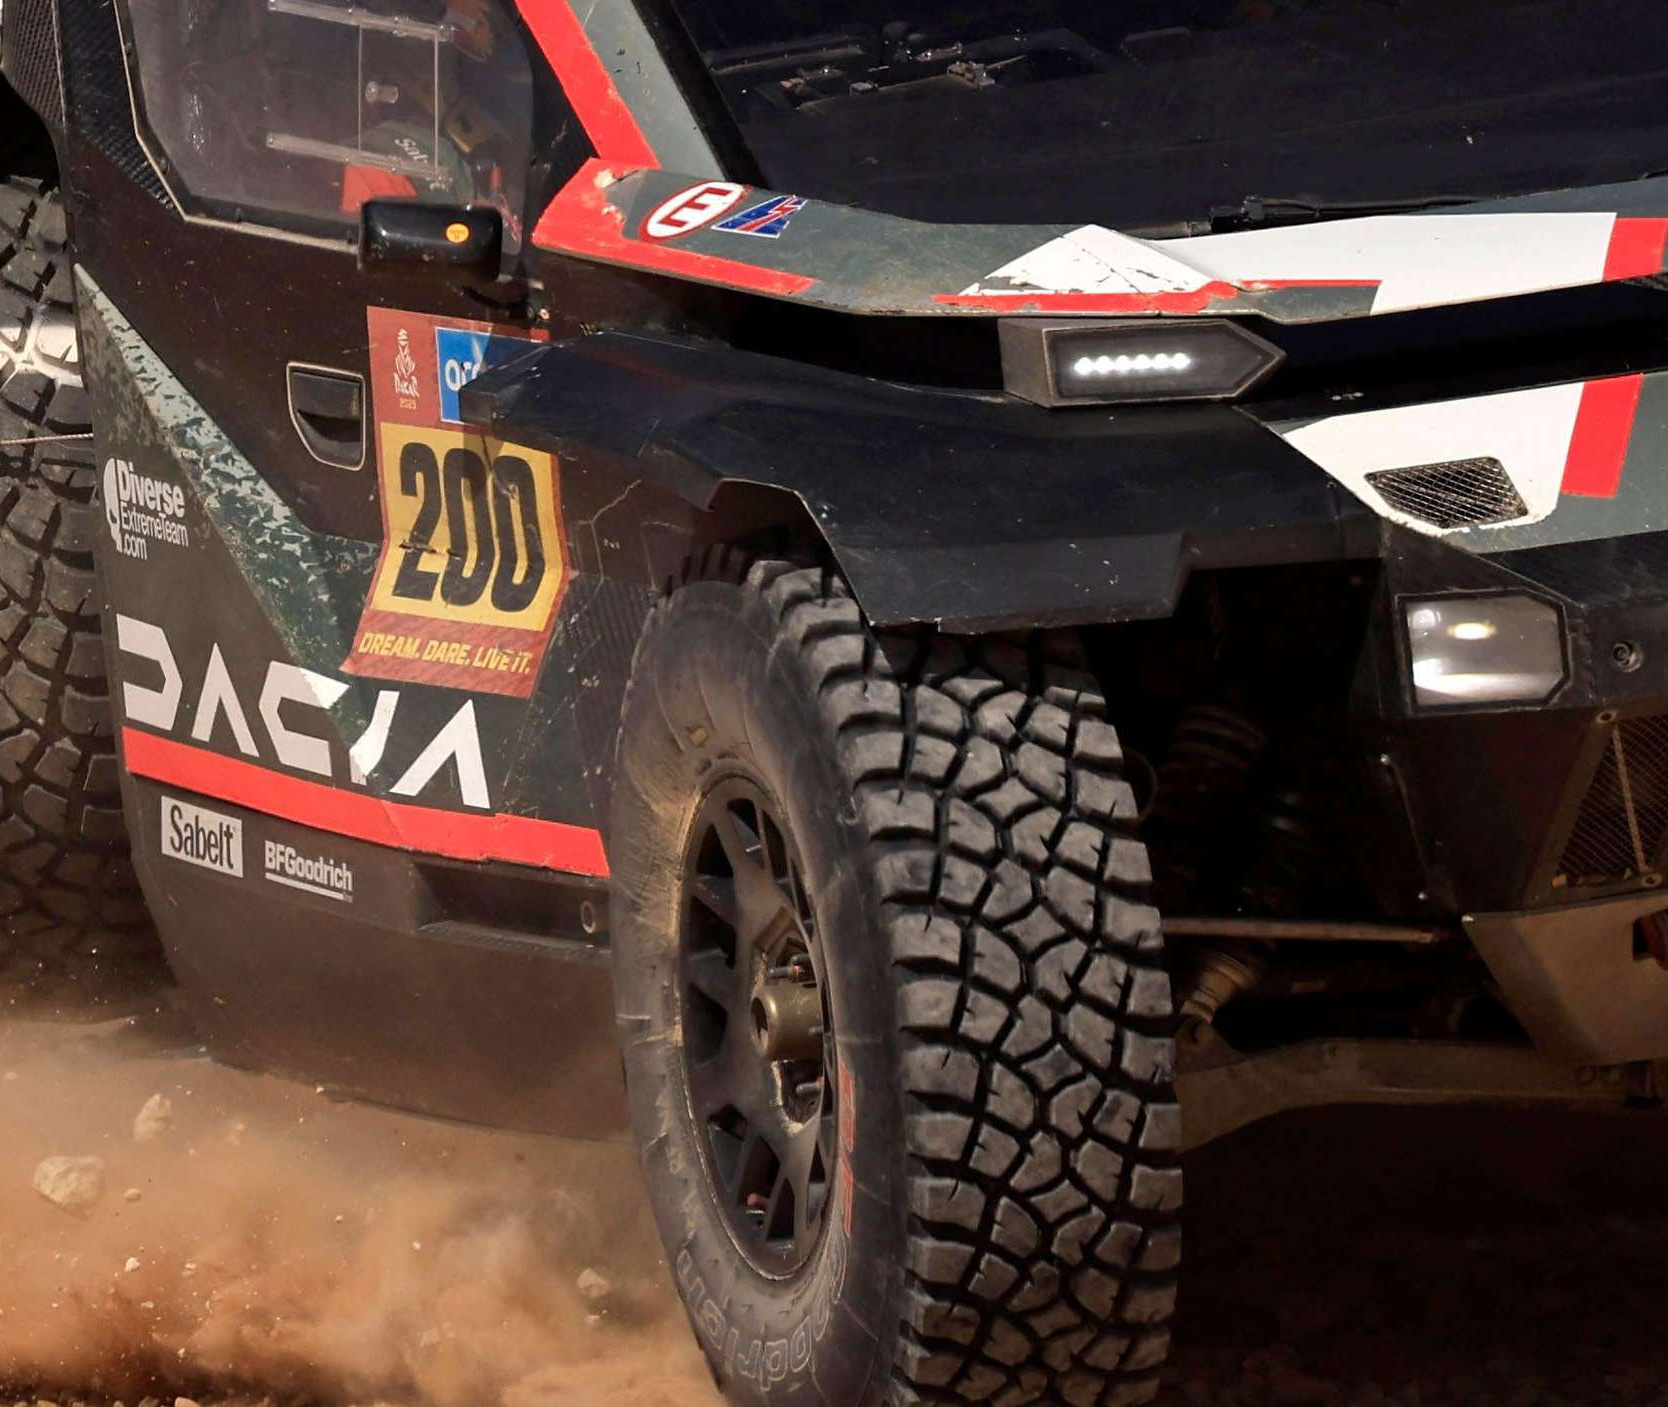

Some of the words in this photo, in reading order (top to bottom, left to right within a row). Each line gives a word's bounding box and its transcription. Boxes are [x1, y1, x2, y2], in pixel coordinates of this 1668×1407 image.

[116, 459, 185, 518] Diverse
[120, 501, 189, 547] ExtremeTeam
[124, 533, 147, 560] .com
[392, 442, 546, 613] 200
[358, 632, 419, 659] DREAM.
[422, 640, 470, 665] DARE.
[472, 647, 511, 672] LIVE
[116, 613, 490, 809] DACIA
[170, 804, 234, 870] Sabelt
[264, 840, 353, 892] BFGoodrich
